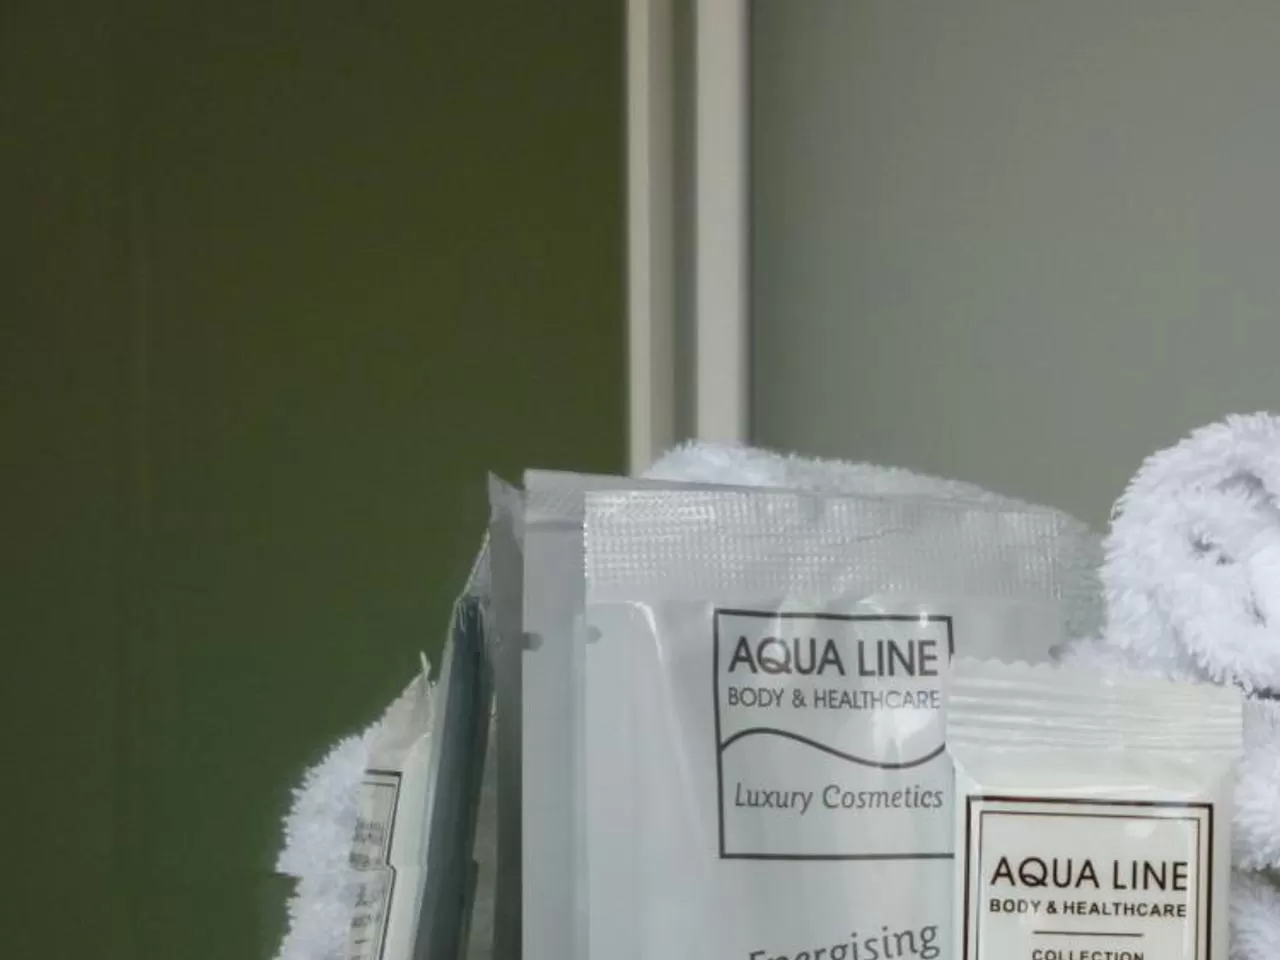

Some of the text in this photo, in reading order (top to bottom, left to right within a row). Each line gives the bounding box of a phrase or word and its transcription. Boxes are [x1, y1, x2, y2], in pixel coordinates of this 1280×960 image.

[728, 636, 938, 677] AQUA LINE
[728, 687, 941, 709] BODY & HEALTHCARE
[735, 783, 943, 814] Luxury Cosmetics
[991, 857, 1188, 891] AQUA LINE
[990, 899, 1187, 918] BODY & HEALTHCARE
